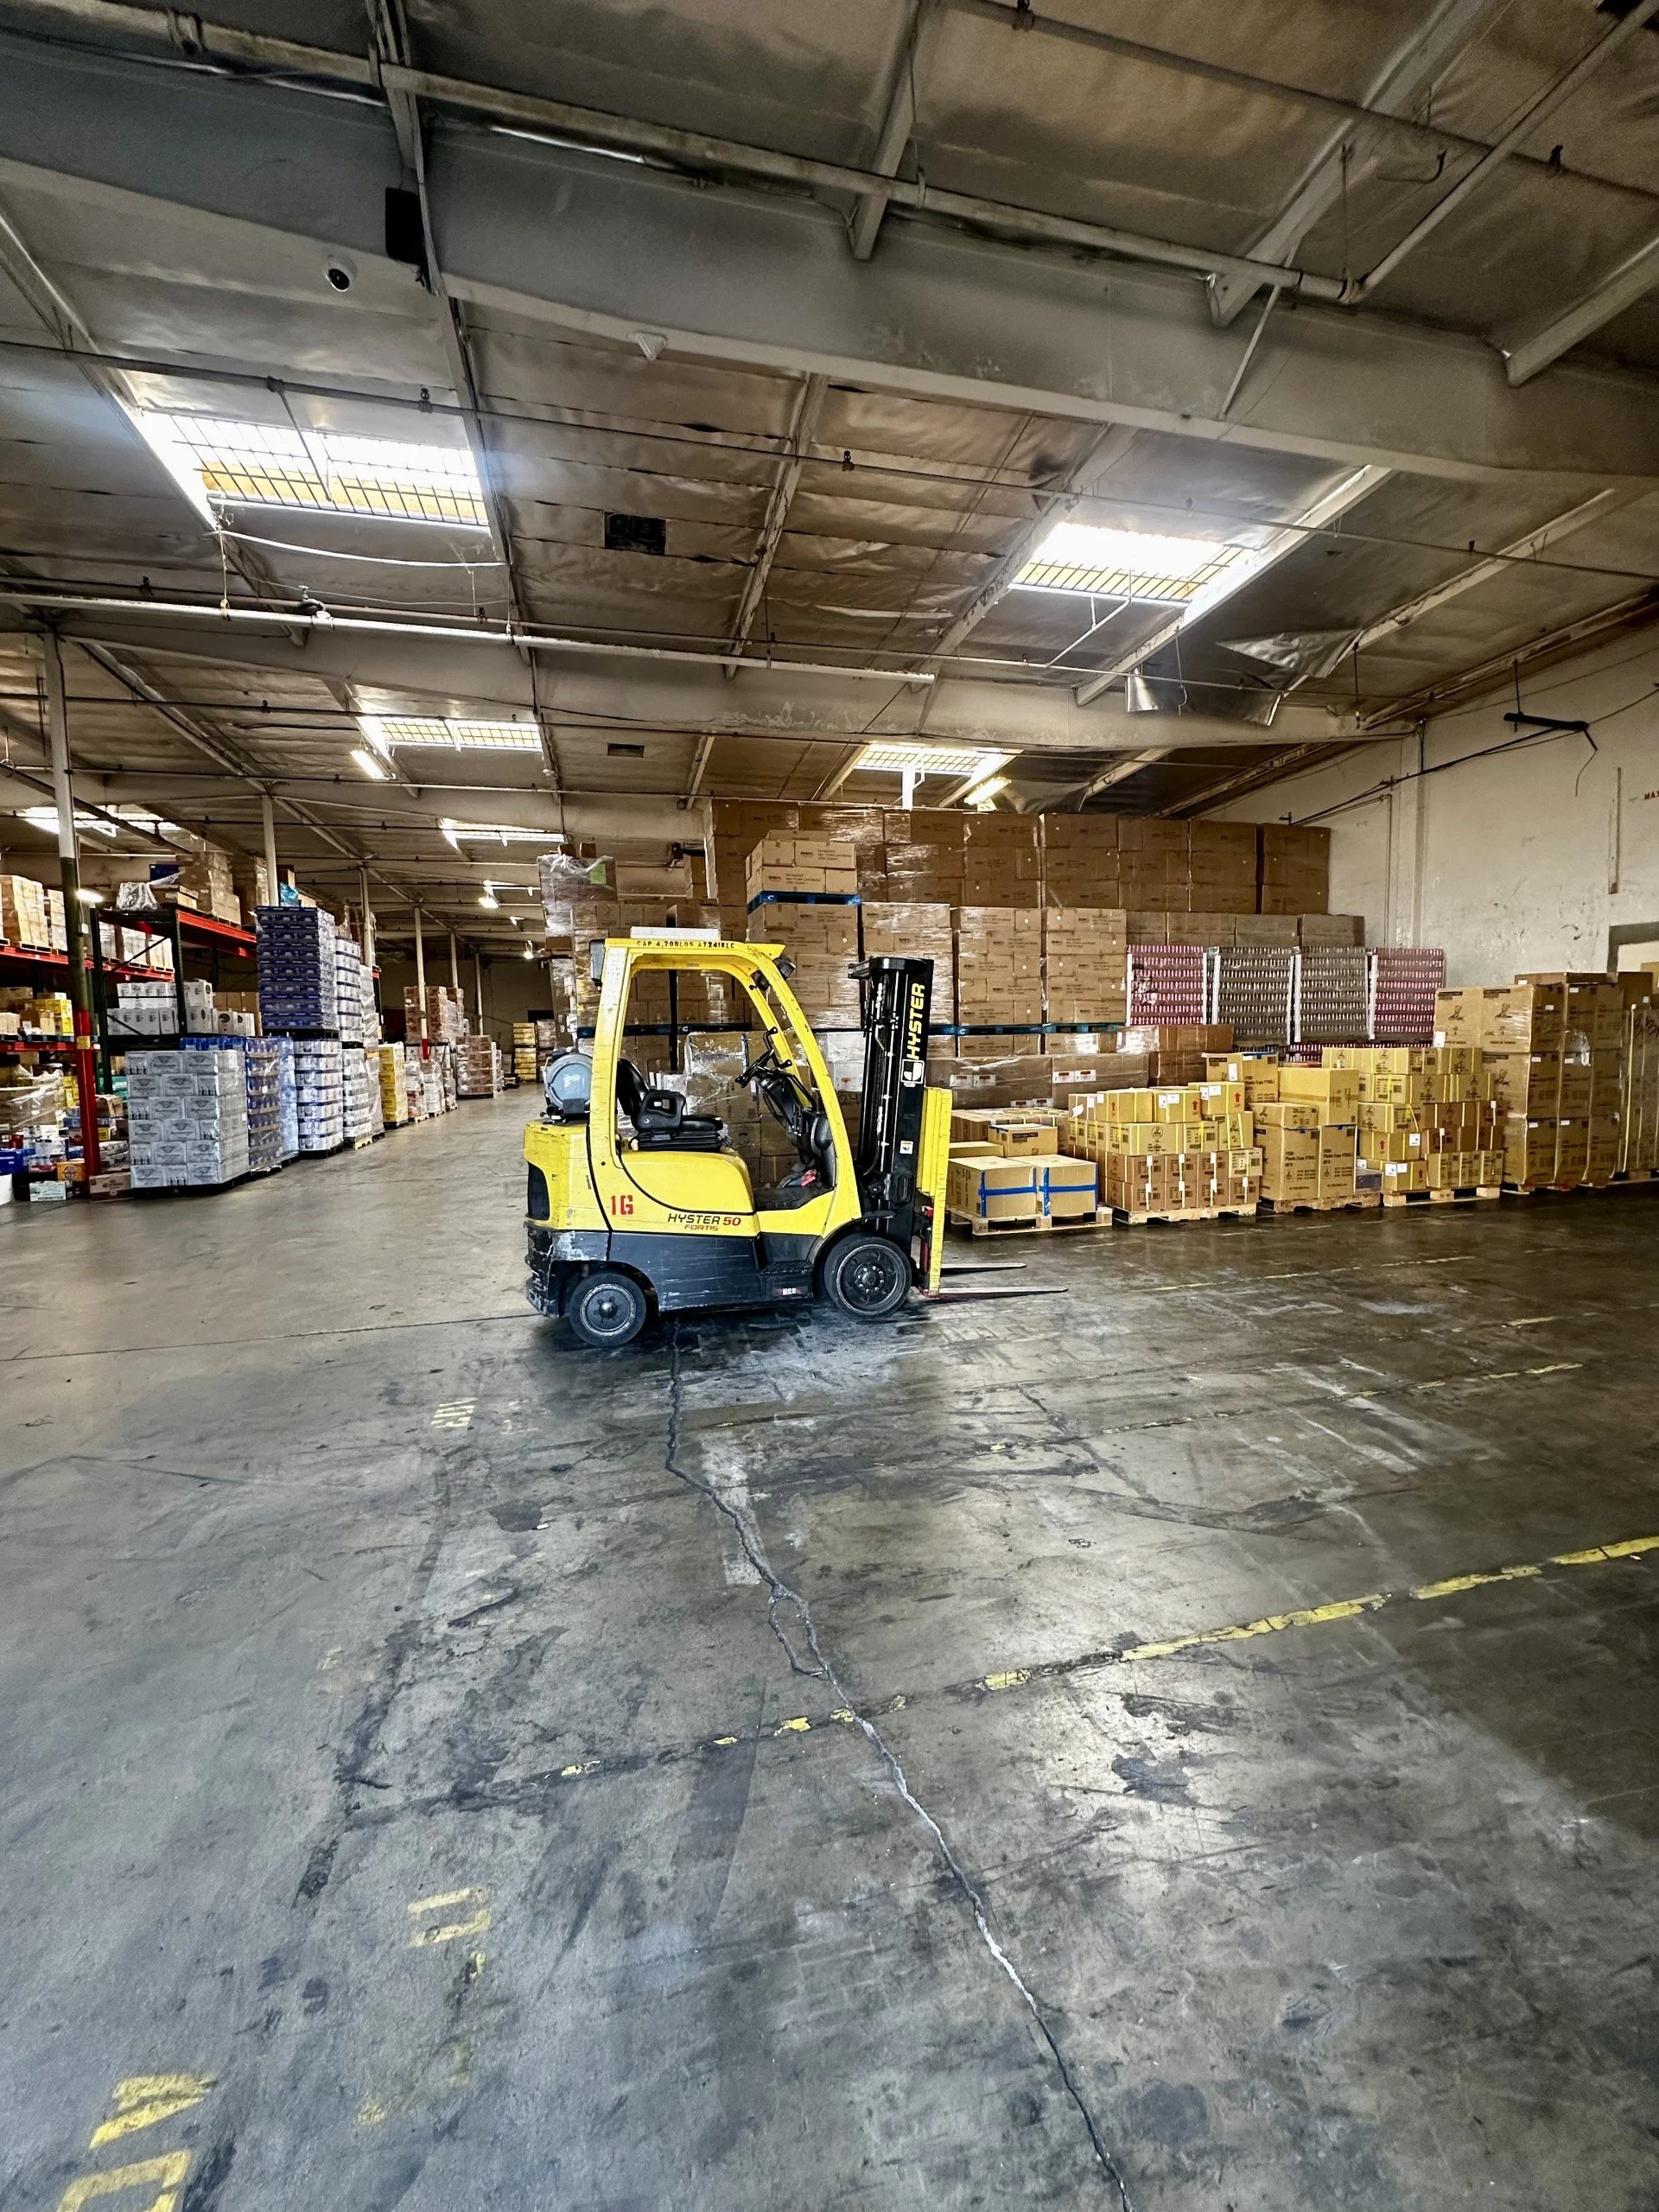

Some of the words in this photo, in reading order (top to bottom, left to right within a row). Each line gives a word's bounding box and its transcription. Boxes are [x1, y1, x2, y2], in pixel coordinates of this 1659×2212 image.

[906, 982, 925, 1060] HYSTER
[667, 1213, 721, 1225] HYSTER
[722, 1217, 741, 1226] 50
